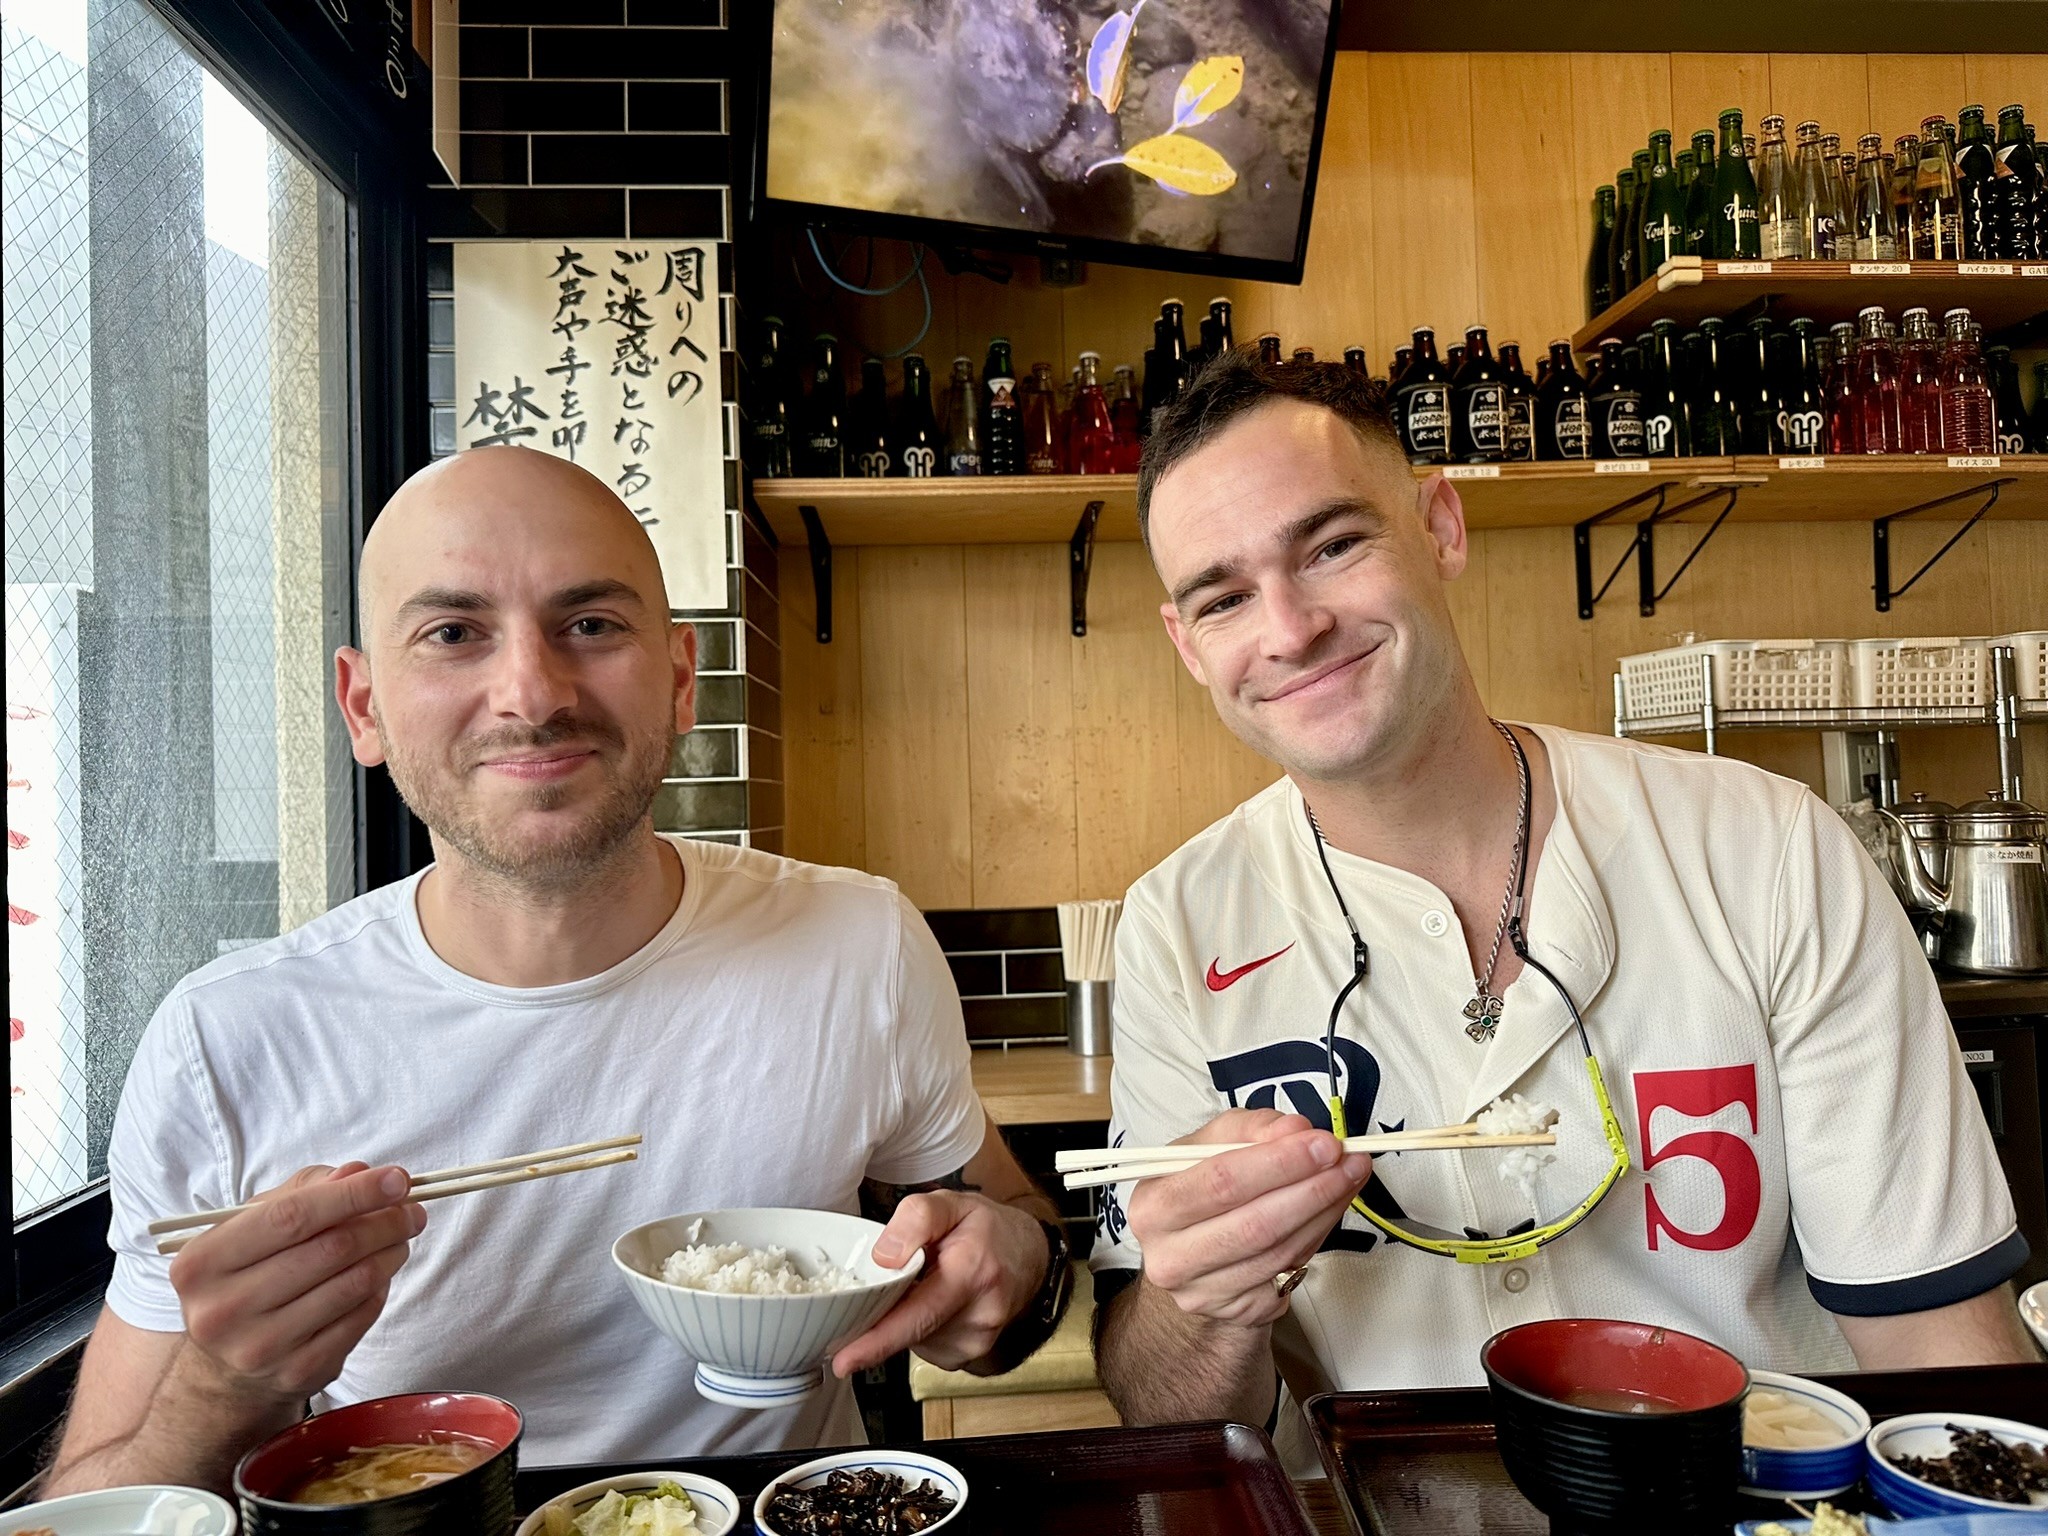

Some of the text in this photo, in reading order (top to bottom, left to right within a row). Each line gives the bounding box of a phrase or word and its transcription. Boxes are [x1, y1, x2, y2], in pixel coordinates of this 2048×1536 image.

[1859, 265, 1888, 273] タンサン
[1966, 265, 2006, 273] ハイカラ 5
[655, 247, 708, 407] 周りへの
[1633, 1064, 1761, 1252] 5
